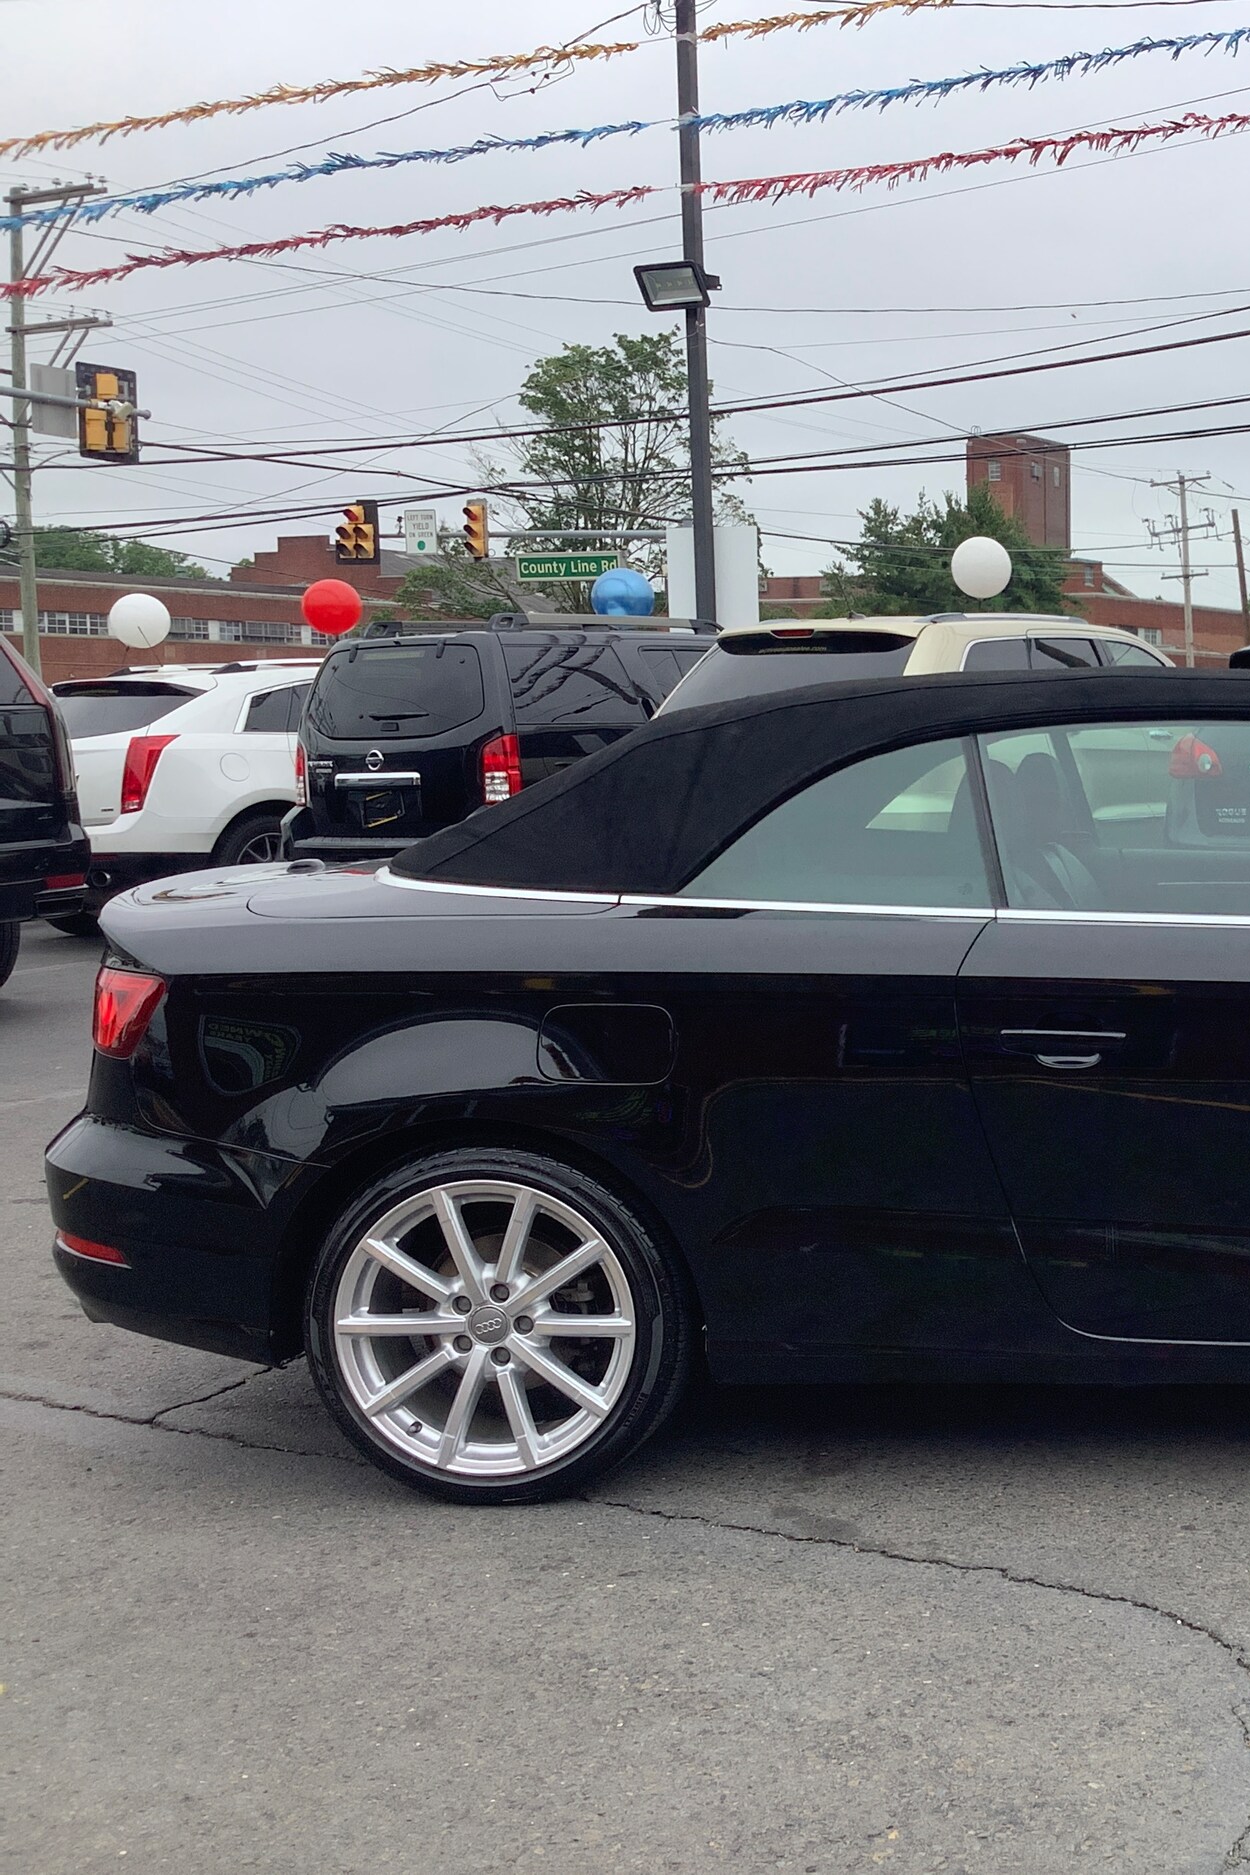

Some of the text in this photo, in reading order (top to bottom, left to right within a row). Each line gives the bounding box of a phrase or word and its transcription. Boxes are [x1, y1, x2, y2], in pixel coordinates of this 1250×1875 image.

[412, 522, 429, 530] YIELD
[520, 559, 617, 576] County Line Rd
